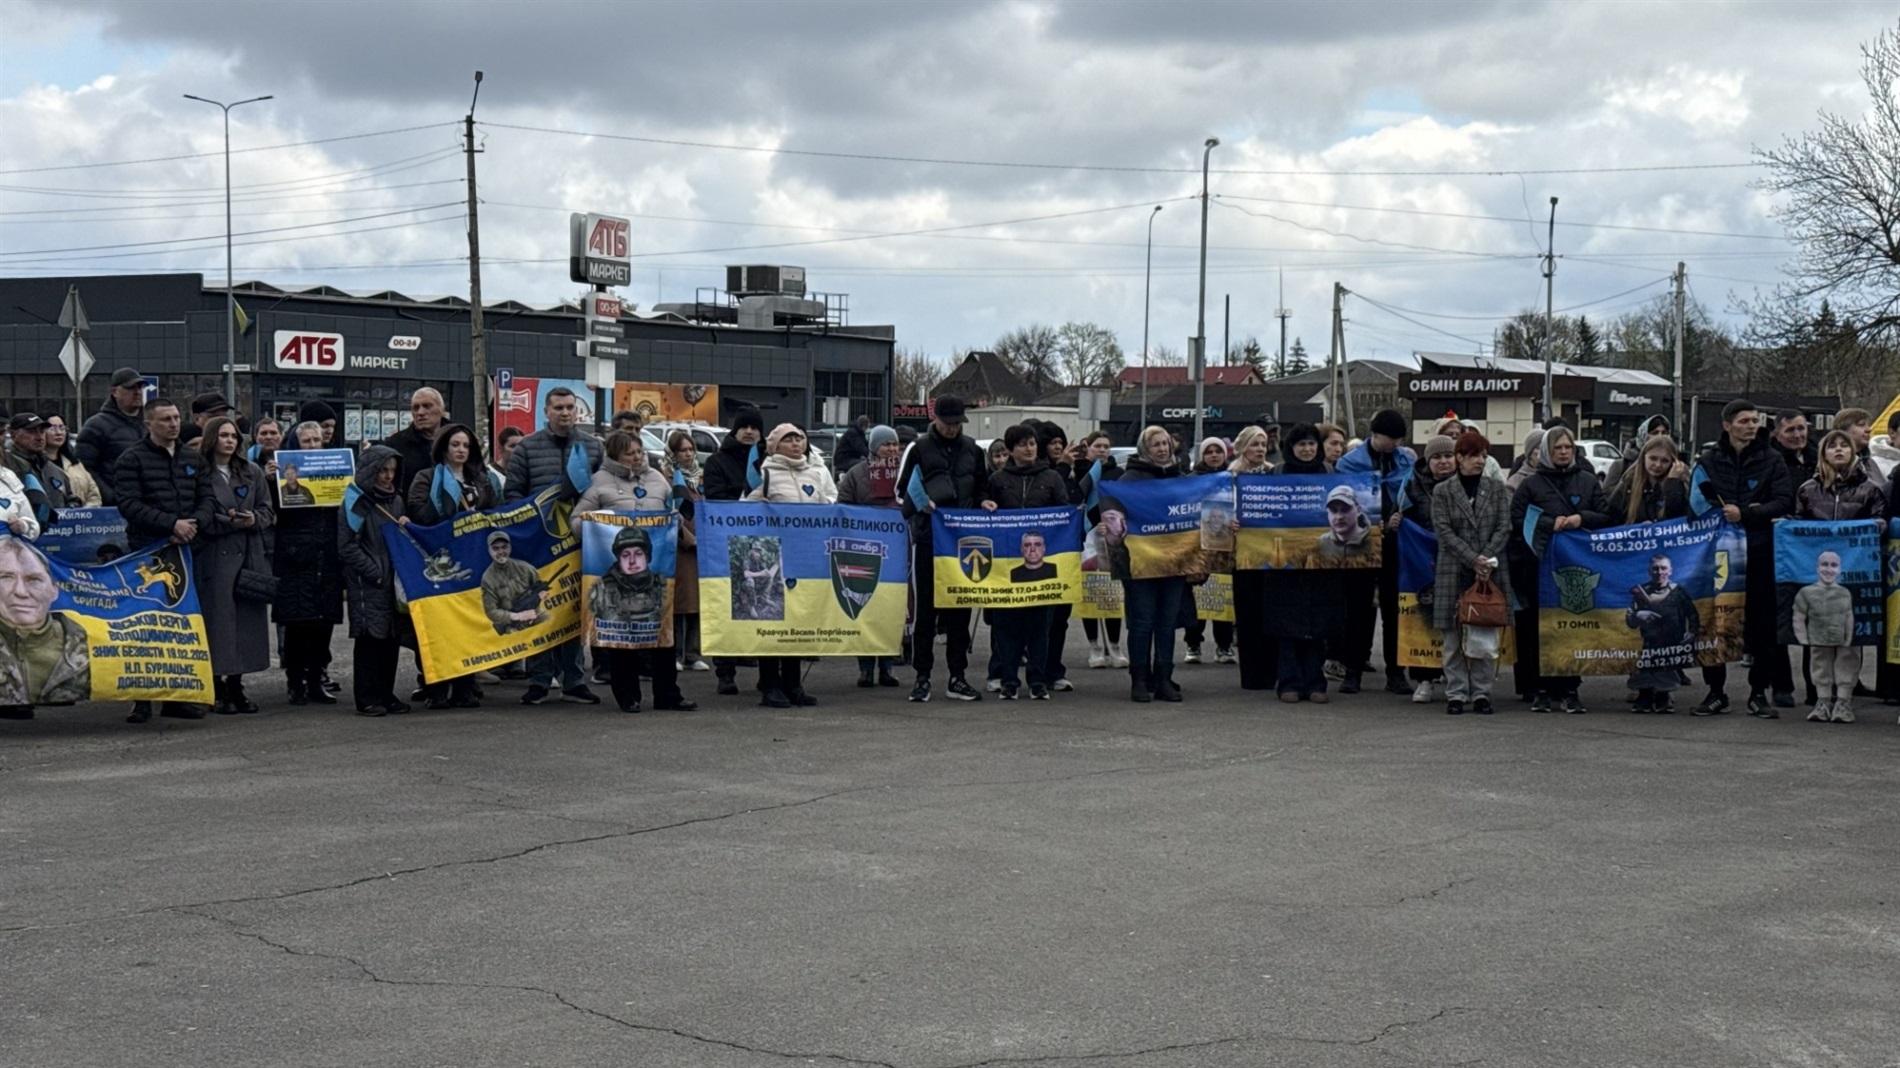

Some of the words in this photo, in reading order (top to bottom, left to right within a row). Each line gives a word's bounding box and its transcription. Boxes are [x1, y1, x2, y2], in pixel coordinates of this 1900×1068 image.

[589, 218, 628, 257] АТБ
[589, 261, 629, 281] МАРКЕТ
[600, 301, 620, 314] 00-24
[393, 338, 417, 347] 00-24
[280, 336, 339, 366] АТБ
[350, 355, 408, 369] МАРКЕТ
[501, 370, 511, 383] P
[1409, 378, 1459, 392] ОБМІН
[1463, 378, 1522, 391] ВАЛЮТ
[870, 470, 881, 480] НЕ
[57, 510, 92, 520] Жилко
[1040, 511, 1069, 519] БРИГАДА
[1168, 502, 1201, 516] ЖЕНЯ
[708, 515, 723, 526] 14
[726, 515, 765, 527] ОМБР
[765, 515, 840, 529] ІМ.РОМАНА
[841, 518, 905, 534] ВЕЛИКОГО
[1141, 523, 1168, 533] СИНУ,
[1176, 521, 1193, 529] ТЕБЕ
[1590, 527, 1652, 542] БЕЗВІСТИ
[1654, 514, 1720, 537] ЗНИКЛИЙ
[550, 544, 562, 556] 57
[834, 539, 846, 550] 14
[1590, 539, 1658, 552] 16.05.2023
[947, 586, 989, 594] БЕЗВІСТИ
[991, 586, 1014, 594] ЗНИК
[1015, 583, 1062, 594] 17.04.2023
[543, 588, 579, 610] СЕРГІЙ
[956, 595, 1011, 605] ДОНЕЦЬКИЙ
[1012, 593, 1062, 604] НАПРЯМОК
[158, 614, 192, 630] СЕРГІЙ
[1557, 620, 1568, 629] 37
[1569, 620, 1600, 629] ОМПБ
[1855, 622, 1871, 635] 24
[108, 628, 201, 646] ВОЛОДИМИРОВИЧ
[756, 628, 789, 638] Кравчук
[790, 628, 815, 636] Василь
[816, 627, 861, 638] Георгійович
[92, 646, 120, 657] ЗНИК
[121, 646, 165, 658] БЕЗВІСТИ
[166, 647, 209, 662] 19.02.2025
[470, 651, 502, 666] БОРОВСЯ
[501, 648, 513, 658] ЗА
[512, 642, 528, 654] НАС
[532, 637, 546, 648] МИ
[1410, 648, 1433, 657] ІВАН
[1574, 648, 1639, 660] ШЕЛАЙКІН
[1641, 644, 1693, 659] ДМИТРО
[1636, 653, 1694, 669] 08.12.1975
[124, 662, 144, 674] Н.П.
[145, 662, 198, 677] БУРЛАЦЬКЕ,
[117, 676, 168, 690] ДОНЕЦЬКА
[168, 677, 204, 691] ОБЛАСТЬ
